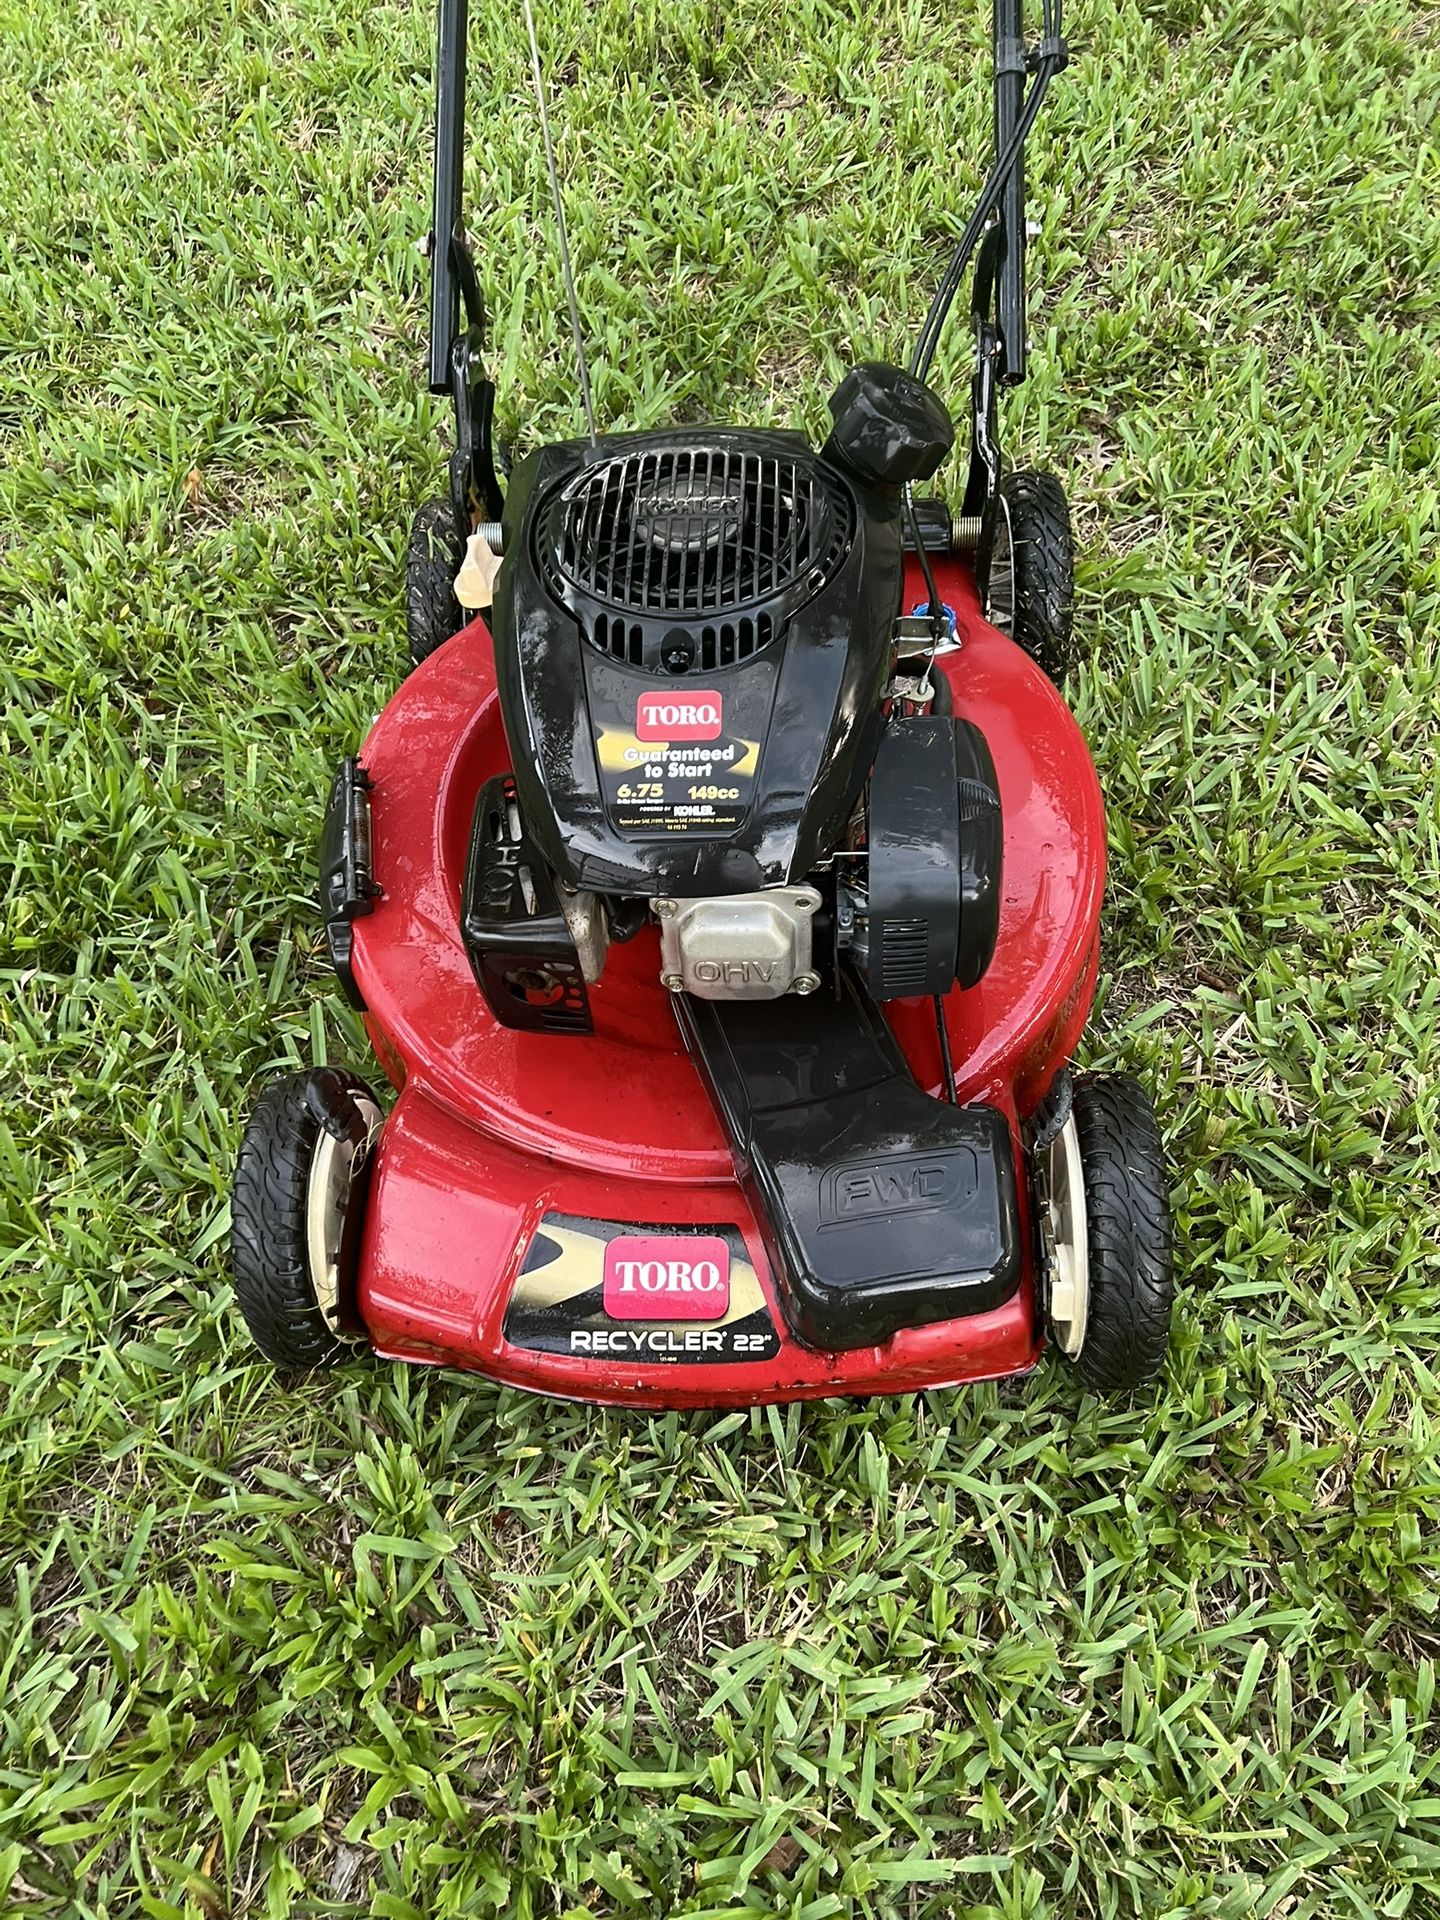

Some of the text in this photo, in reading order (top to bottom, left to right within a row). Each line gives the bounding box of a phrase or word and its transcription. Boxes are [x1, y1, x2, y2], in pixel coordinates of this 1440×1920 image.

[624, 744, 734, 762] Guaranteed
[644, 762, 713, 778] to Start
[616, 783, 664, 798] 6.75
[687, 785, 740, 800] 149cc
[479, 845, 521, 914] HOT
[694, 961, 778, 984] OHV
[843, 1165, 949, 1209] FWD
